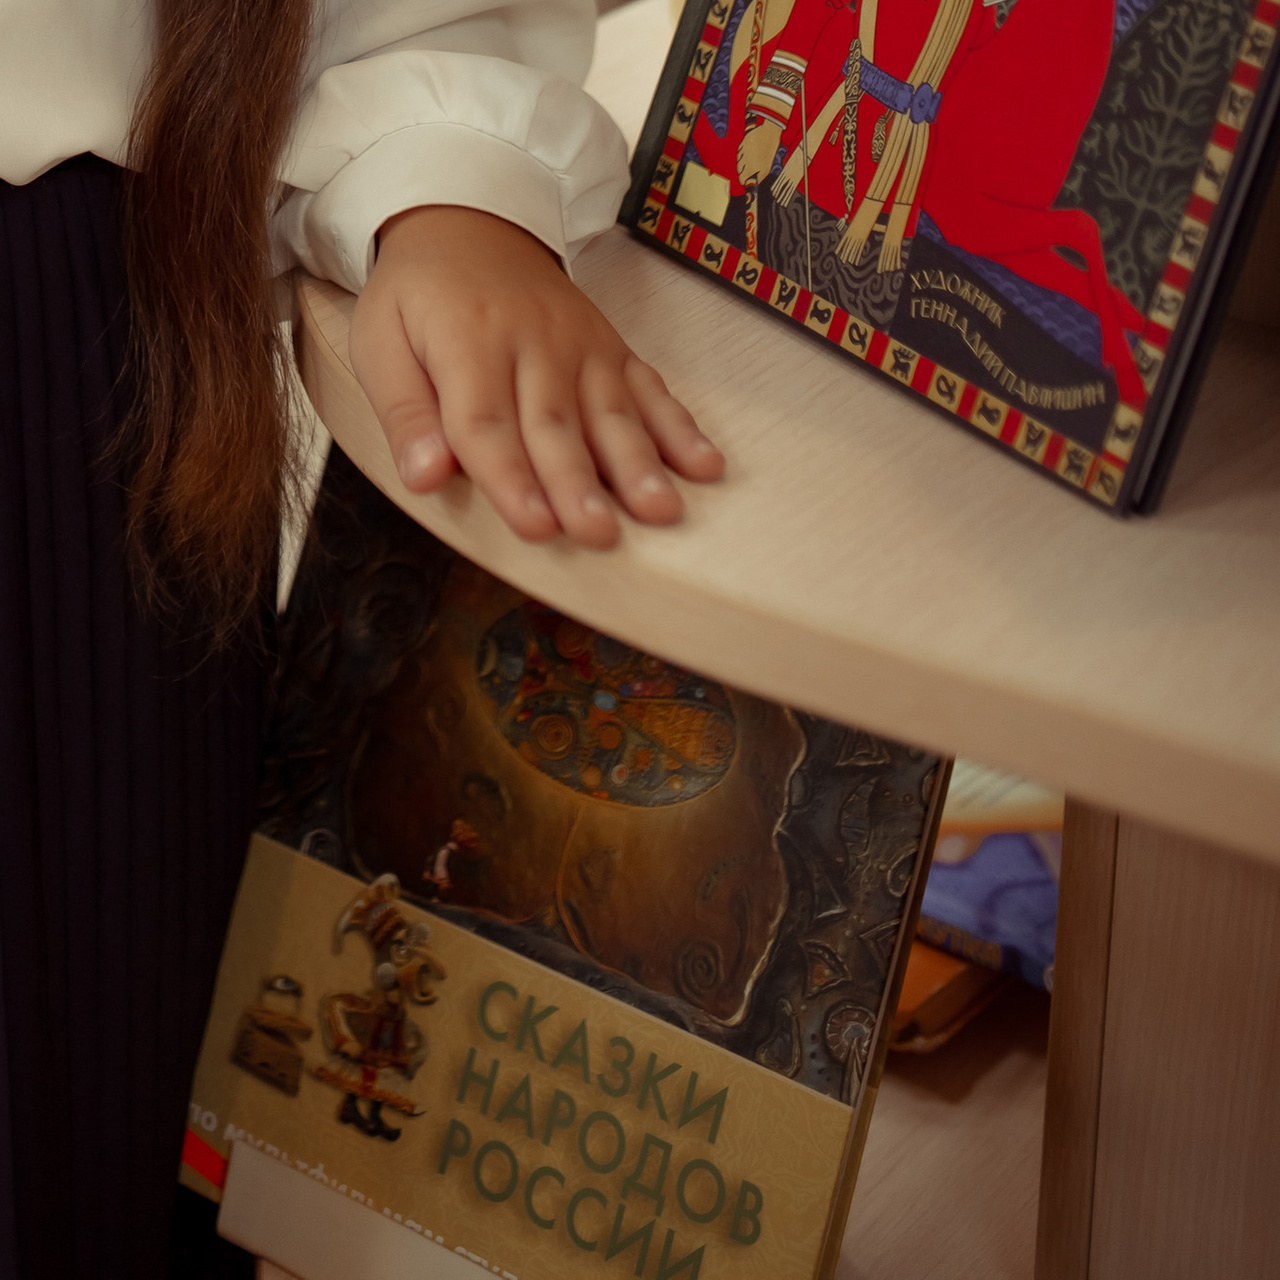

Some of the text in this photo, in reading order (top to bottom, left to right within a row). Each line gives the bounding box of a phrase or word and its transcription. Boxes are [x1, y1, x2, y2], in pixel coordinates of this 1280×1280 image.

[910, 268, 1007, 329] ХУДОЖНИК
[477, 981, 729, 1144] СКАЗКИ
[437, 1118, 706, 1280] РОССИИ
[456, 1047, 764, 1246] НАРОДОВ
